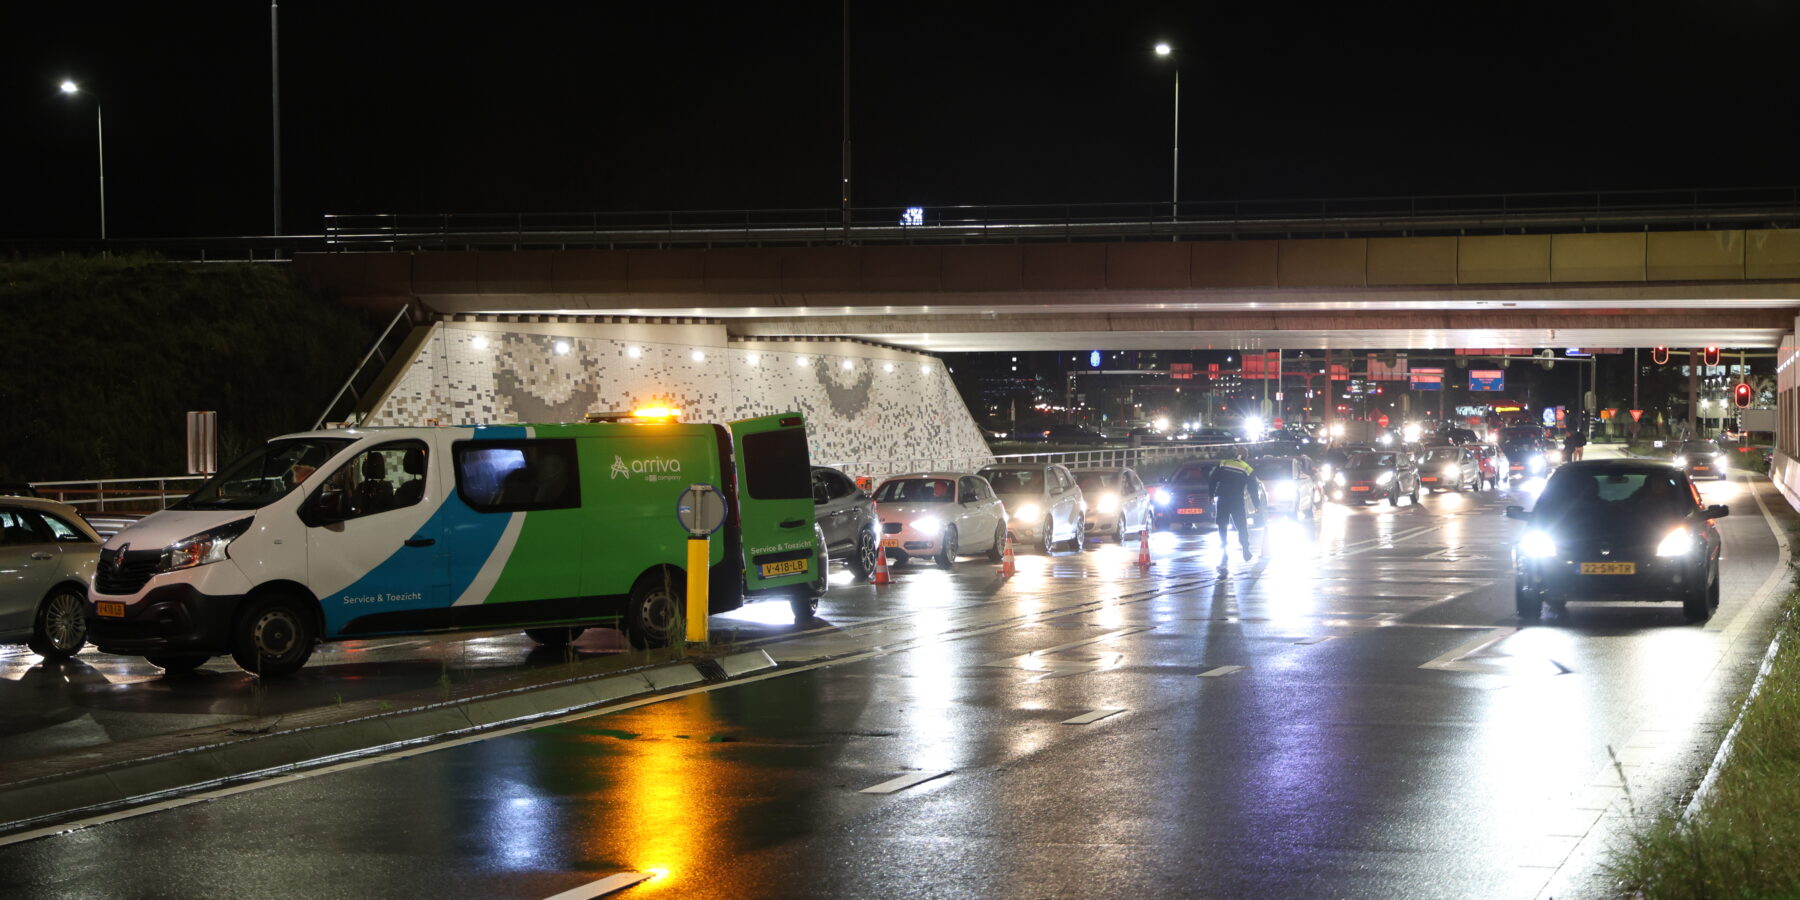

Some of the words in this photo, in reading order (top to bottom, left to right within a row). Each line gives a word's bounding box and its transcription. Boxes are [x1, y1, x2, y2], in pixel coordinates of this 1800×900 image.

[631, 456, 681, 473] arriva
[750, 545, 777, 555] Service
[783, 540, 812, 549] Toezicht
[766, 560, 803, 574] V-418-LB
[343, 594, 375, 605] Service
[377, 593, 384, 602] &
[386, 591, 422, 602] Toezicht
